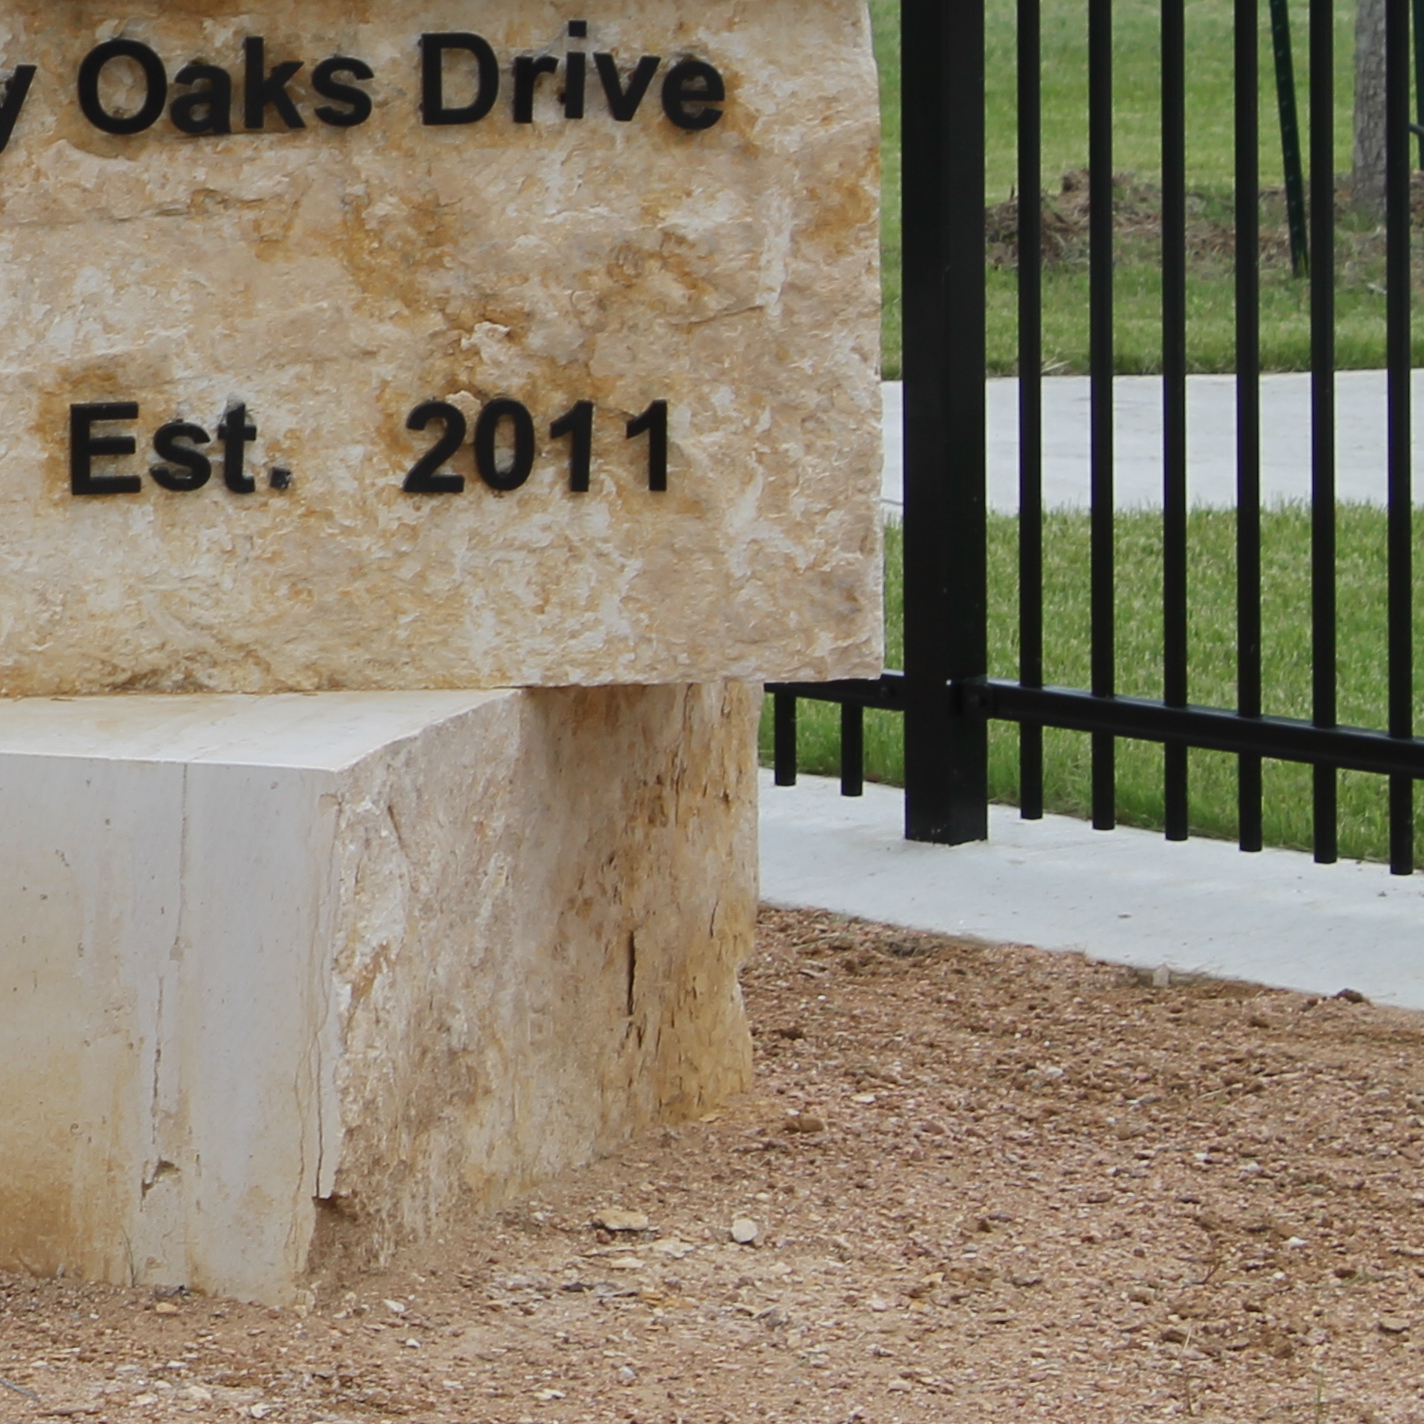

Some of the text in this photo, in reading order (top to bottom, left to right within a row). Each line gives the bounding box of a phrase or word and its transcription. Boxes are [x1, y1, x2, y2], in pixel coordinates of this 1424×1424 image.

[78, 37, 373, 137] Oaks
[419, 21, 724, 132] Drive
[71, 398, 667, 495] Est. 2011
